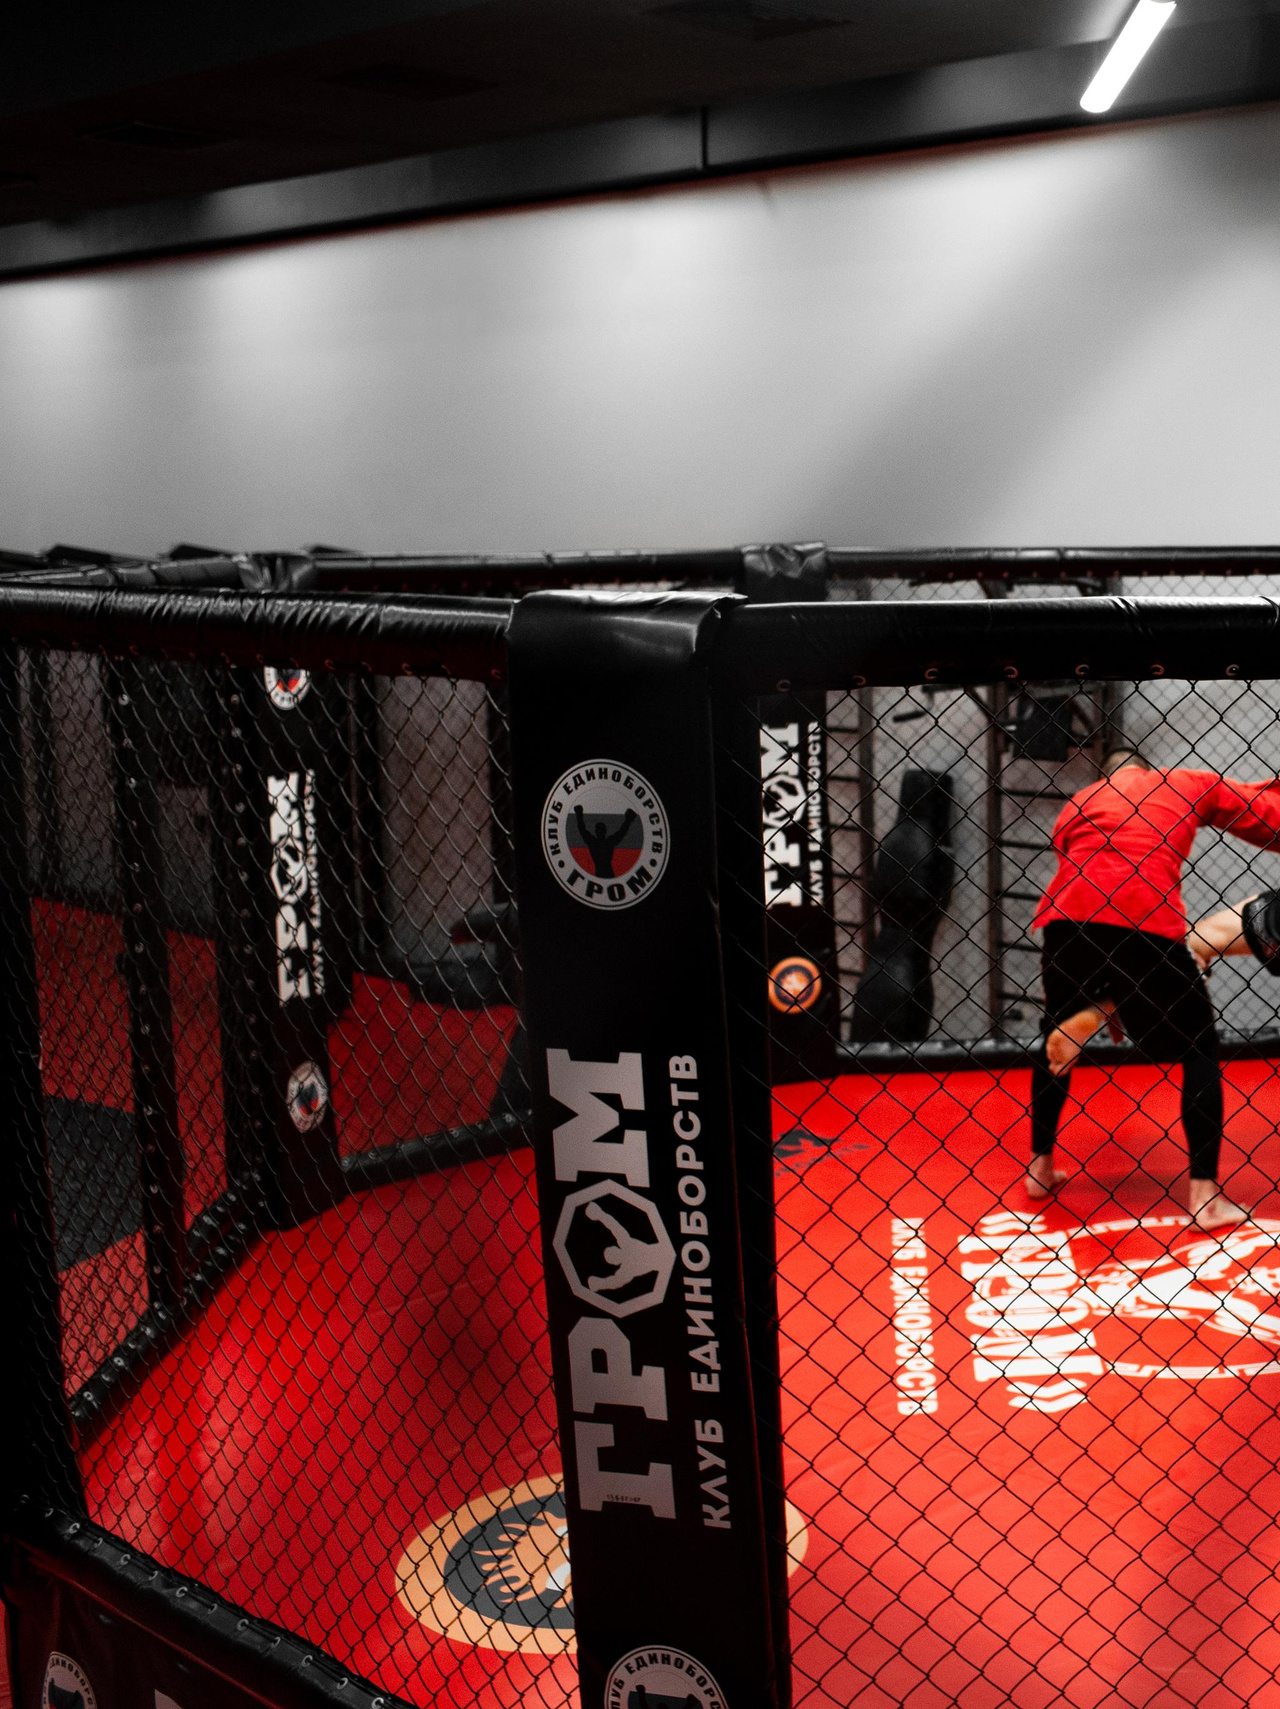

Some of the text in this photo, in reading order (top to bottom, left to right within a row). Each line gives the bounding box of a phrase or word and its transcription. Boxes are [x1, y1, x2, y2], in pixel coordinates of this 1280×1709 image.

[562, 767, 664, 854] ЕДИНОБОРСТВ
[566, 865, 654, 902] ГРОМ
[546, 1047, 677, 1520] ГРОМ
[668, 1053, 732, 1530] КЛУБ ЕДИНОБОРСТВ
[610, 1652, 720, 1709] ЛУБ ЕДИНОБОРС
